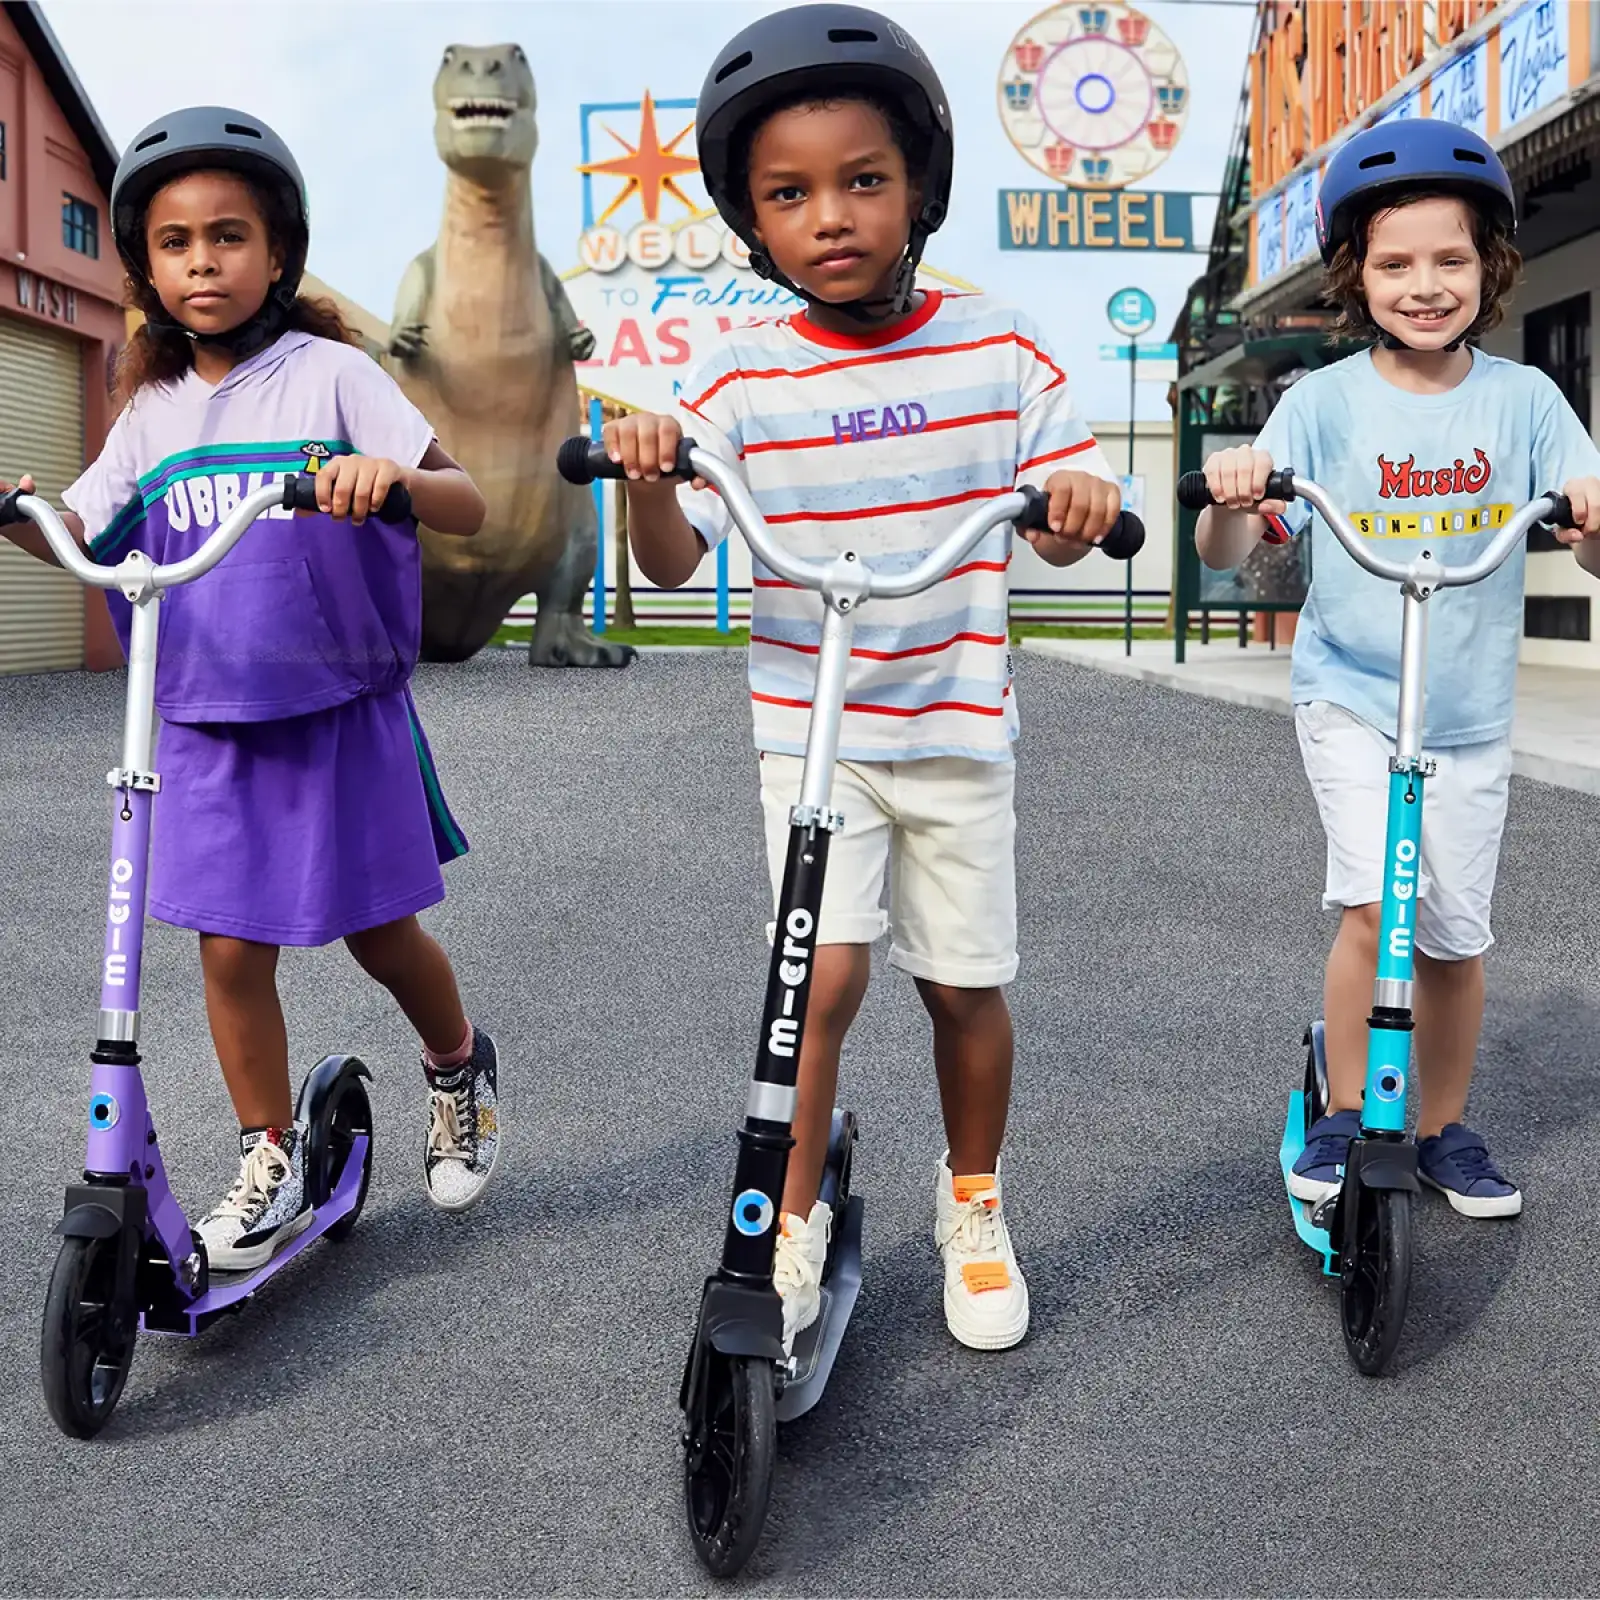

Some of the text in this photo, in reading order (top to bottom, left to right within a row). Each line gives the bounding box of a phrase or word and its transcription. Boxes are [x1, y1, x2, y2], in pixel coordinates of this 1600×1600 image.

[1006, 192, 1185, 247] WHEEL
[18, 270, 77, 324] WASH
[601, 288, 639, 306] TO
[1377, 448, 1491, 499] Music
